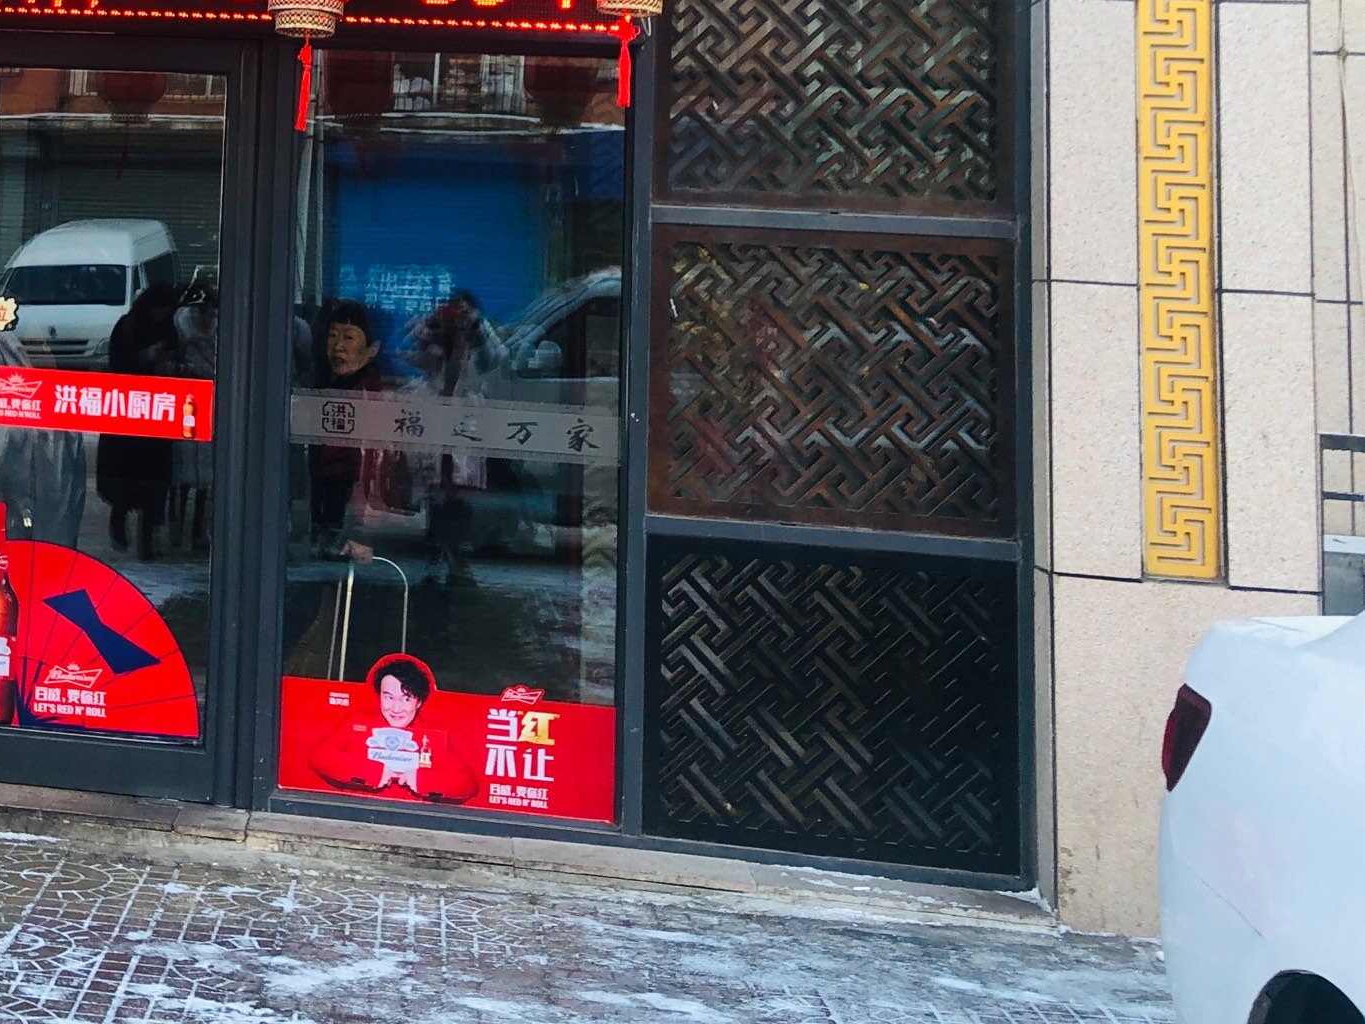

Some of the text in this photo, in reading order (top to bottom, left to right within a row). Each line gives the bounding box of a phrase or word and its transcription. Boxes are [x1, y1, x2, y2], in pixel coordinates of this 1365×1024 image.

[54, 383, 177, 422] 洪福小厨房
[48, 666, 96, 683] Budweiser
[33, 701, 57, 714] LET'S
[56, 703, 75, 715] RED
[85, 706, 107, 719] ROLL
[372, 751, 413, 763] Budweiser
[485, 743, 555, 782] 不让
[488, 795, 508, 805] LET'S
[507, 797, 523, 806] RED
[530, 799, 549, 809] ROLL
